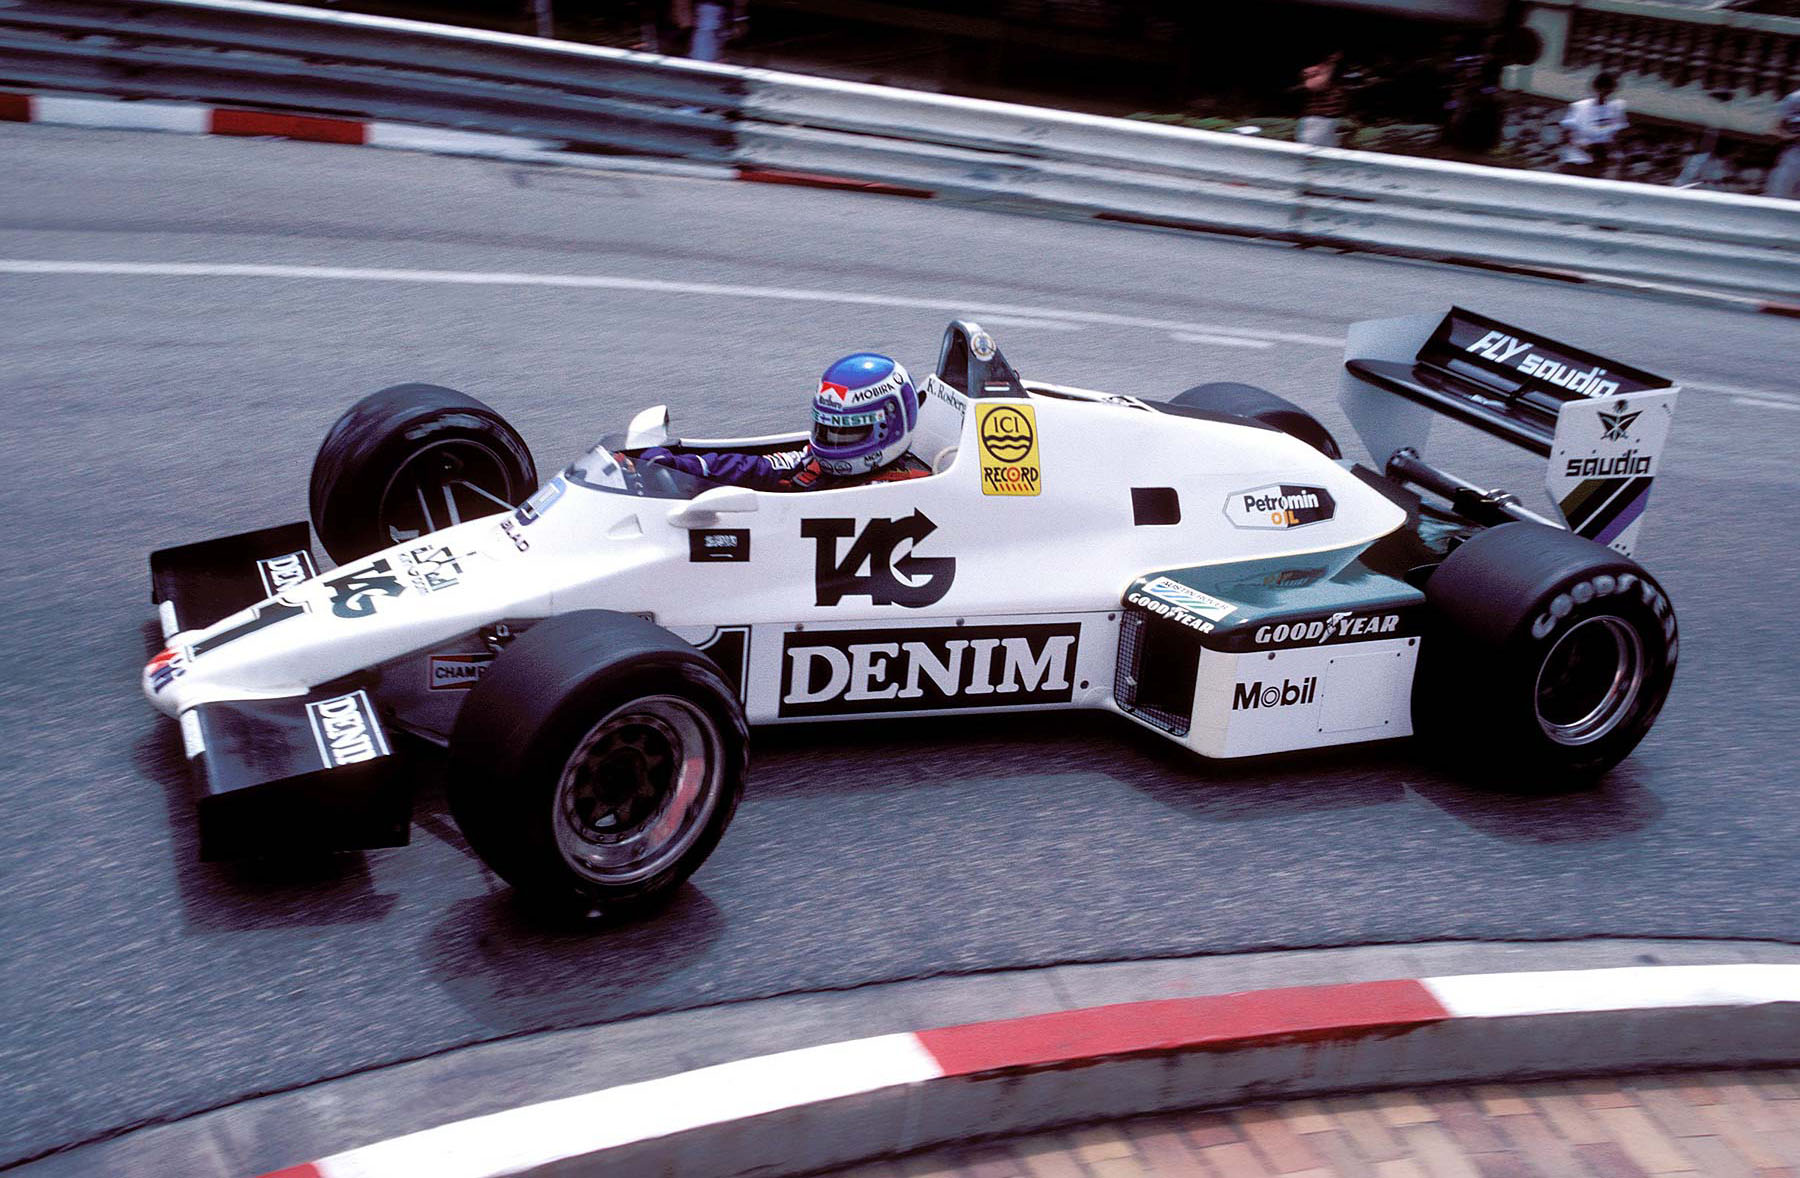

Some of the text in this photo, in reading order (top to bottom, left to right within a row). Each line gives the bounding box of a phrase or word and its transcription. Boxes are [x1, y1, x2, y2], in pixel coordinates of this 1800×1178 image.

[1465, 330, 1621, 399] FLY saudia
[852, 383, 895, 403] MOBIRA
[832, 413, 875, 426] NESTE
[993, 416, 1020, 433] ICI
[1565, 449, 1653, 477] saudia
[984, 466, 1039, 491] RECORD
[1244, 490, 1320, 513] Petromin
[1271, 511, 1300, 525] OIL
[800, 507, 957, 609] TAG
[323, 558, 406, 619] TAG
[1128, 592, 1215, 634] GOODYEAR
[1255, 612, 1400, 644] GOODYEAR
[783, 635, 1076, 705] DENIM
[1232, 676, 1318, 711] Mobil
